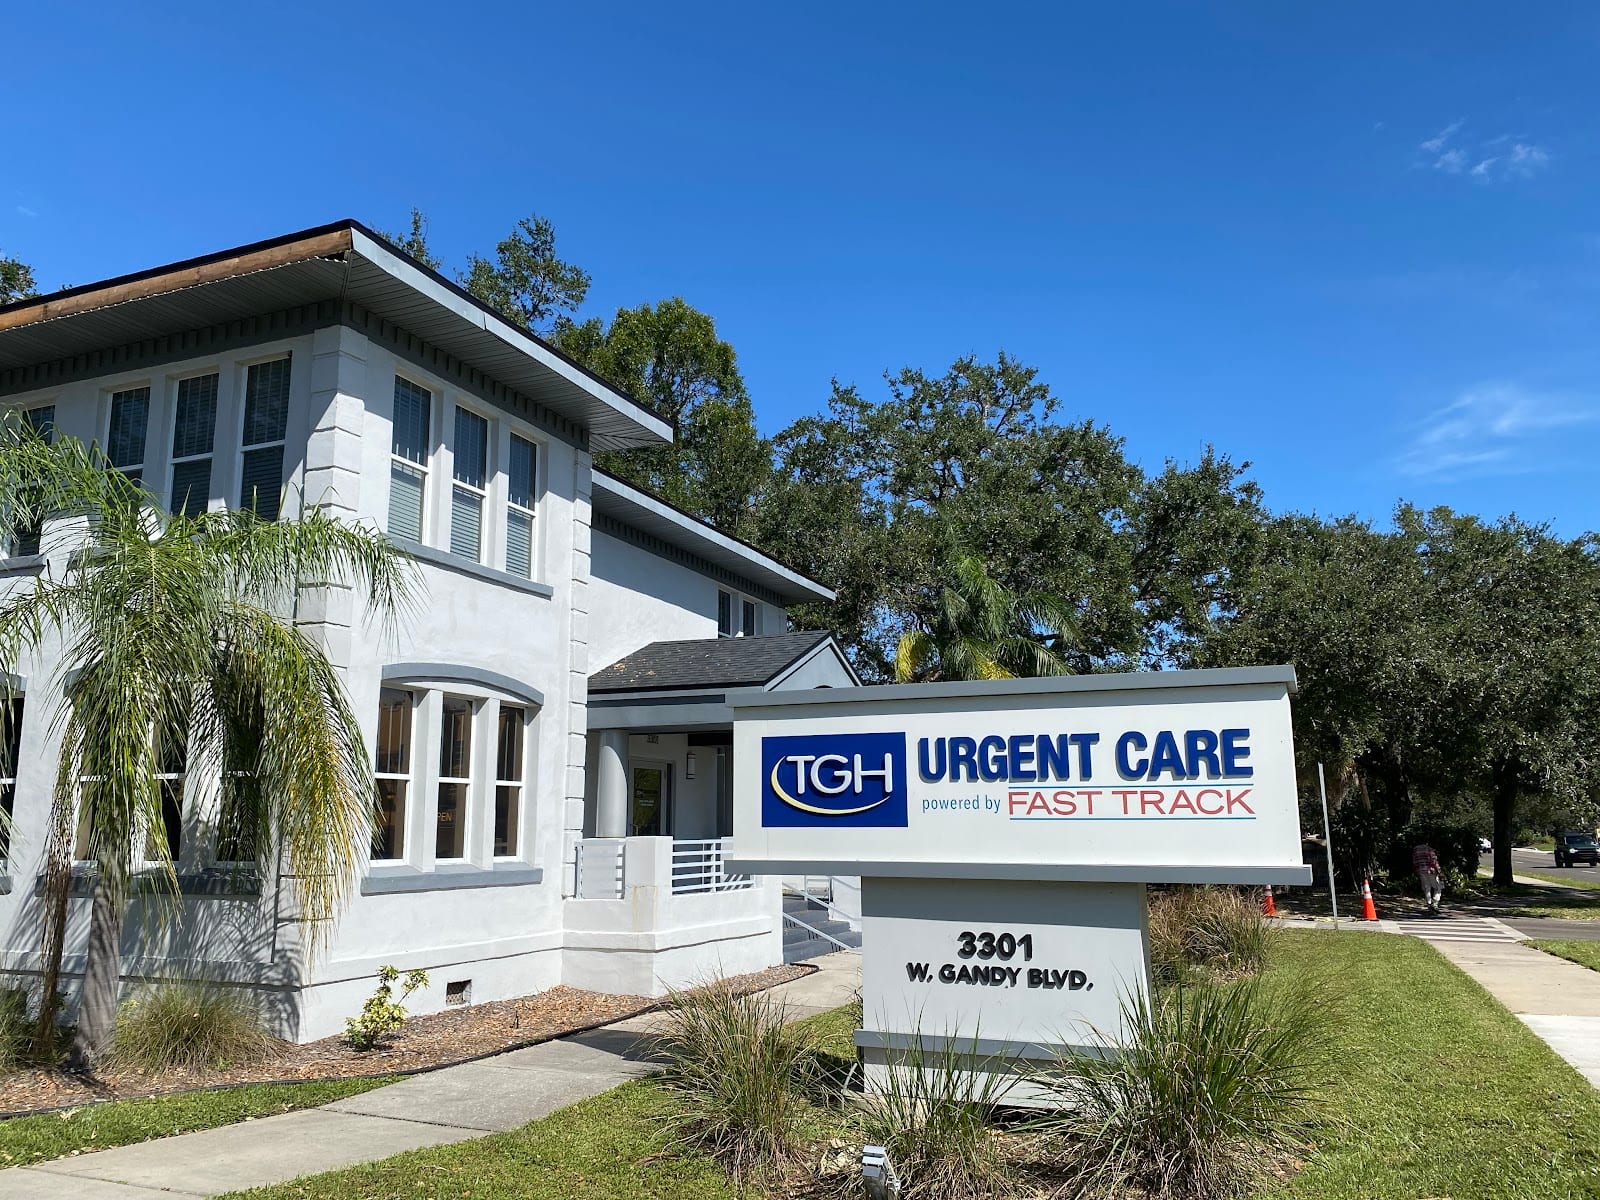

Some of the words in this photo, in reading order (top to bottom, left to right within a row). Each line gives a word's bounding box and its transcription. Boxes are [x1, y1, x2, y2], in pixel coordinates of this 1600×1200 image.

[918, 733, 1099, 783] URGENT
[1115, 728, 1254, 781] CARE
[786, 752, 893, 795] TGH
[922, 795, 981, 814] powered
[985, 795, 1001, 813] by
[1008, 791, 1102, 815] FAST
[1111, 789, 1255, 815] TRACK
[437, 812, 453, 822] PEN
[957, 932, 1033, 961] 3301
[939, 963, 1022, 987] GANDY
